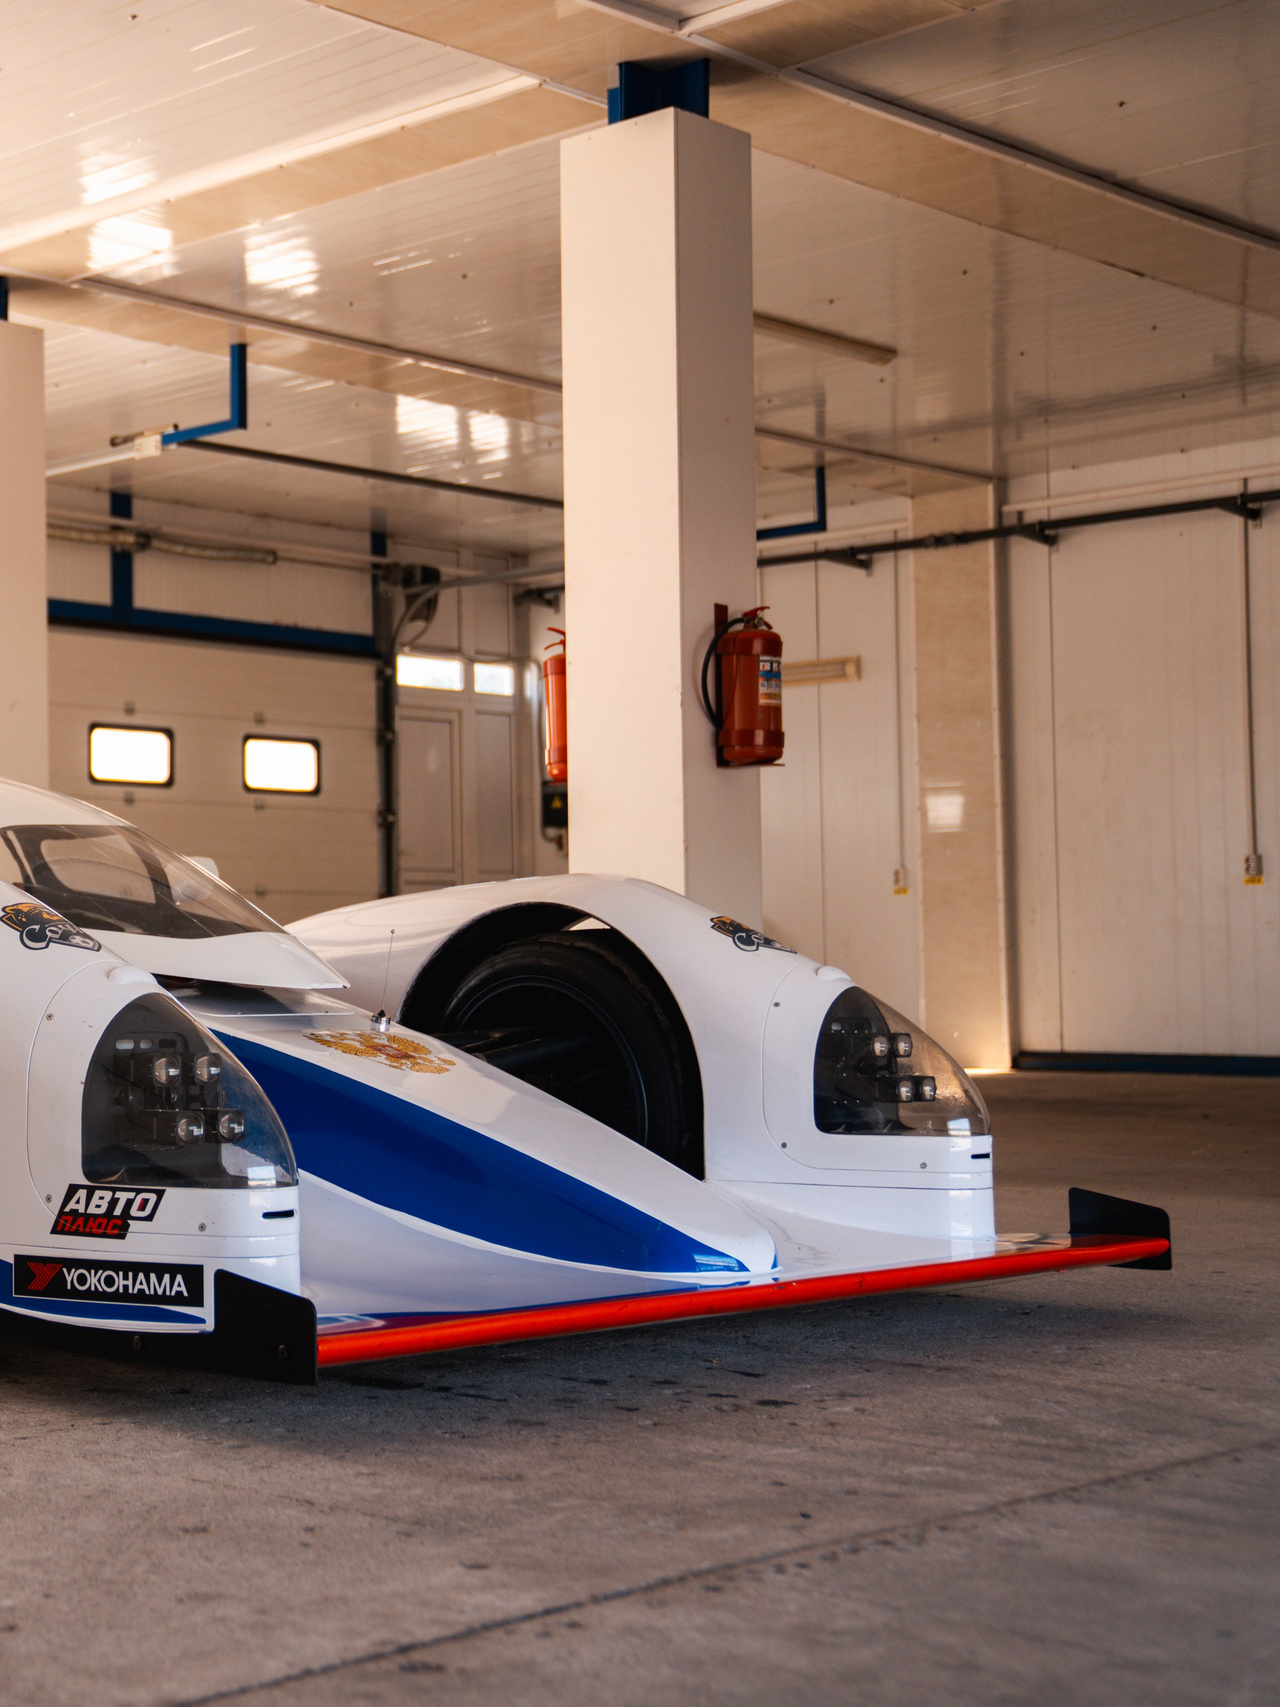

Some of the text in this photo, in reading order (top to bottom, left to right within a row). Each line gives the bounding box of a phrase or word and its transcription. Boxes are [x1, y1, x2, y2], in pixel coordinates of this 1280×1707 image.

[64, 1190, 158, 1217] АВТО
[57, 1216, 123, 1235] ПЛЮС
[62, 1267, 188, 1297] YOKOHAMA
